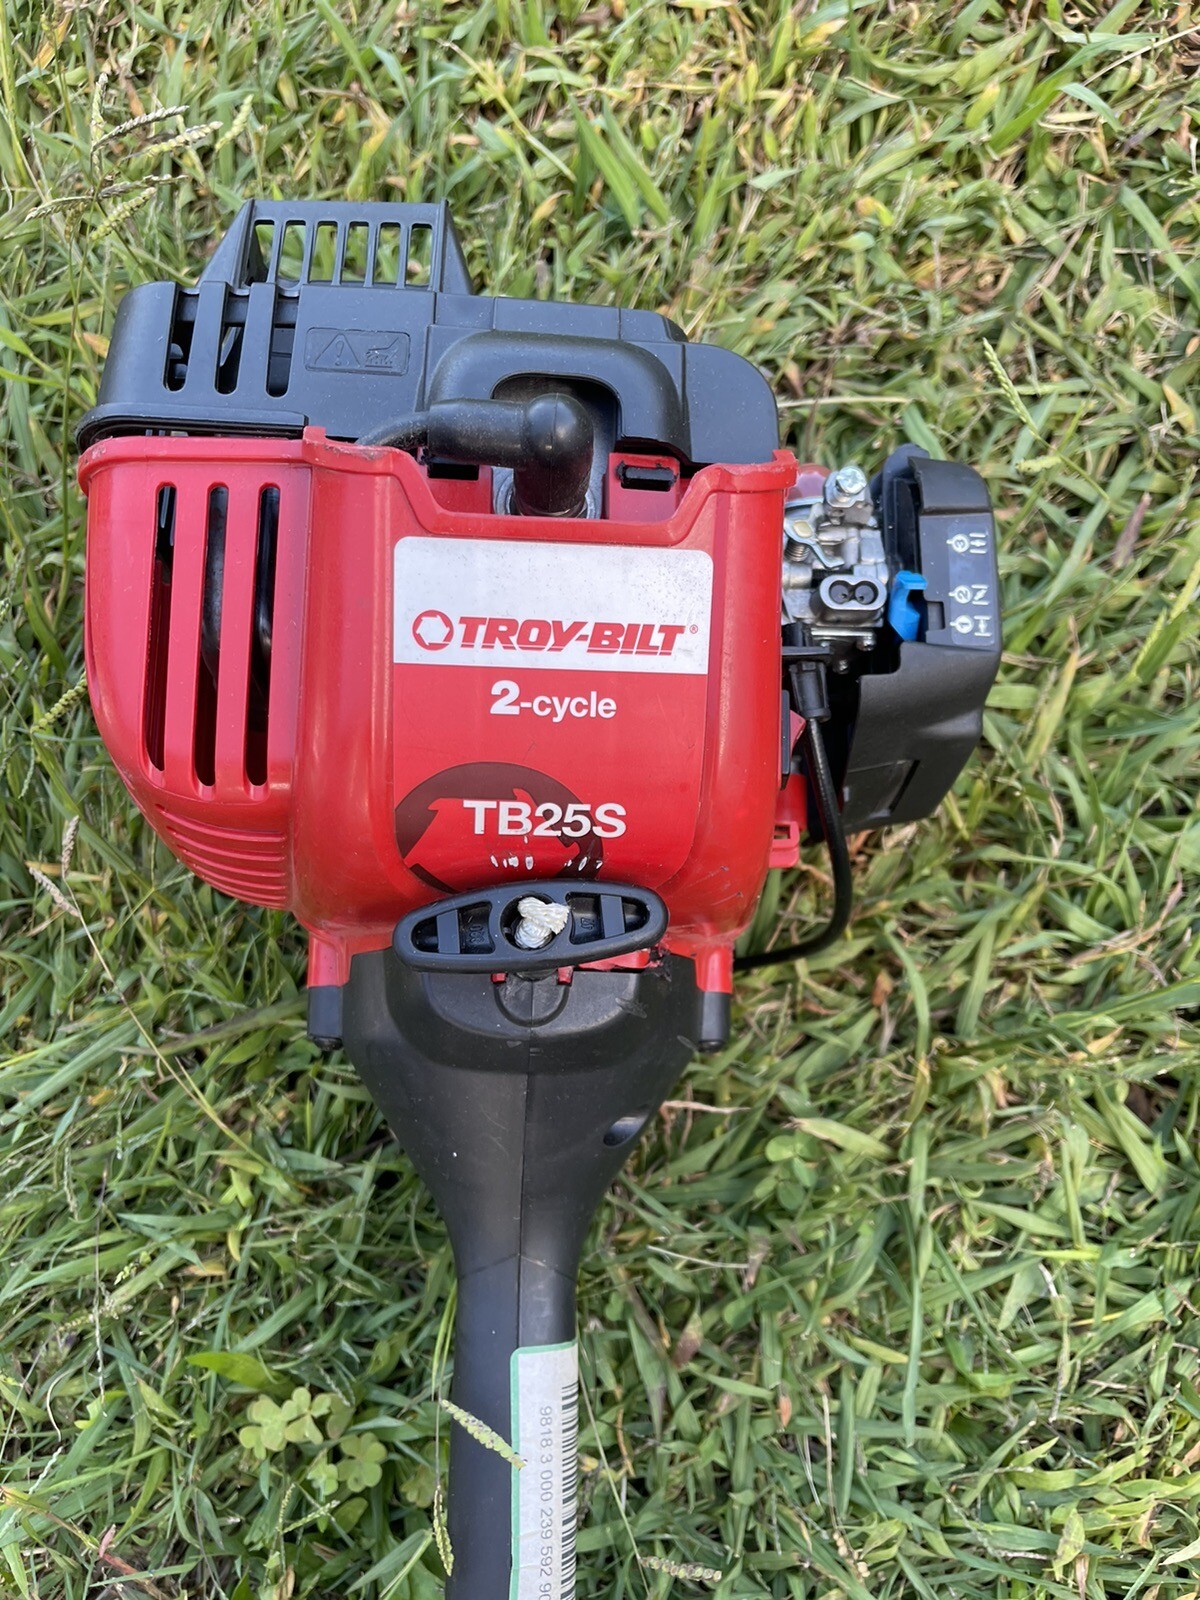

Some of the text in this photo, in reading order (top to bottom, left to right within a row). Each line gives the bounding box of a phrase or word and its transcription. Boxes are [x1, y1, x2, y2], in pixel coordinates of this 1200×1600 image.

[458, 615, 687, 657] TROY-BILT
[490, 680, 618, 723] 2-cycle
[462, 799, 628, 839] TB25S
[540, 1406, 553, 1448] 9818
[540, 1453, 553, 1464] 3
[540, 1469, 553, 1502] 000
[540, 1507, 553, 1540] 239
[540, 1546, 553, 1577] 592
